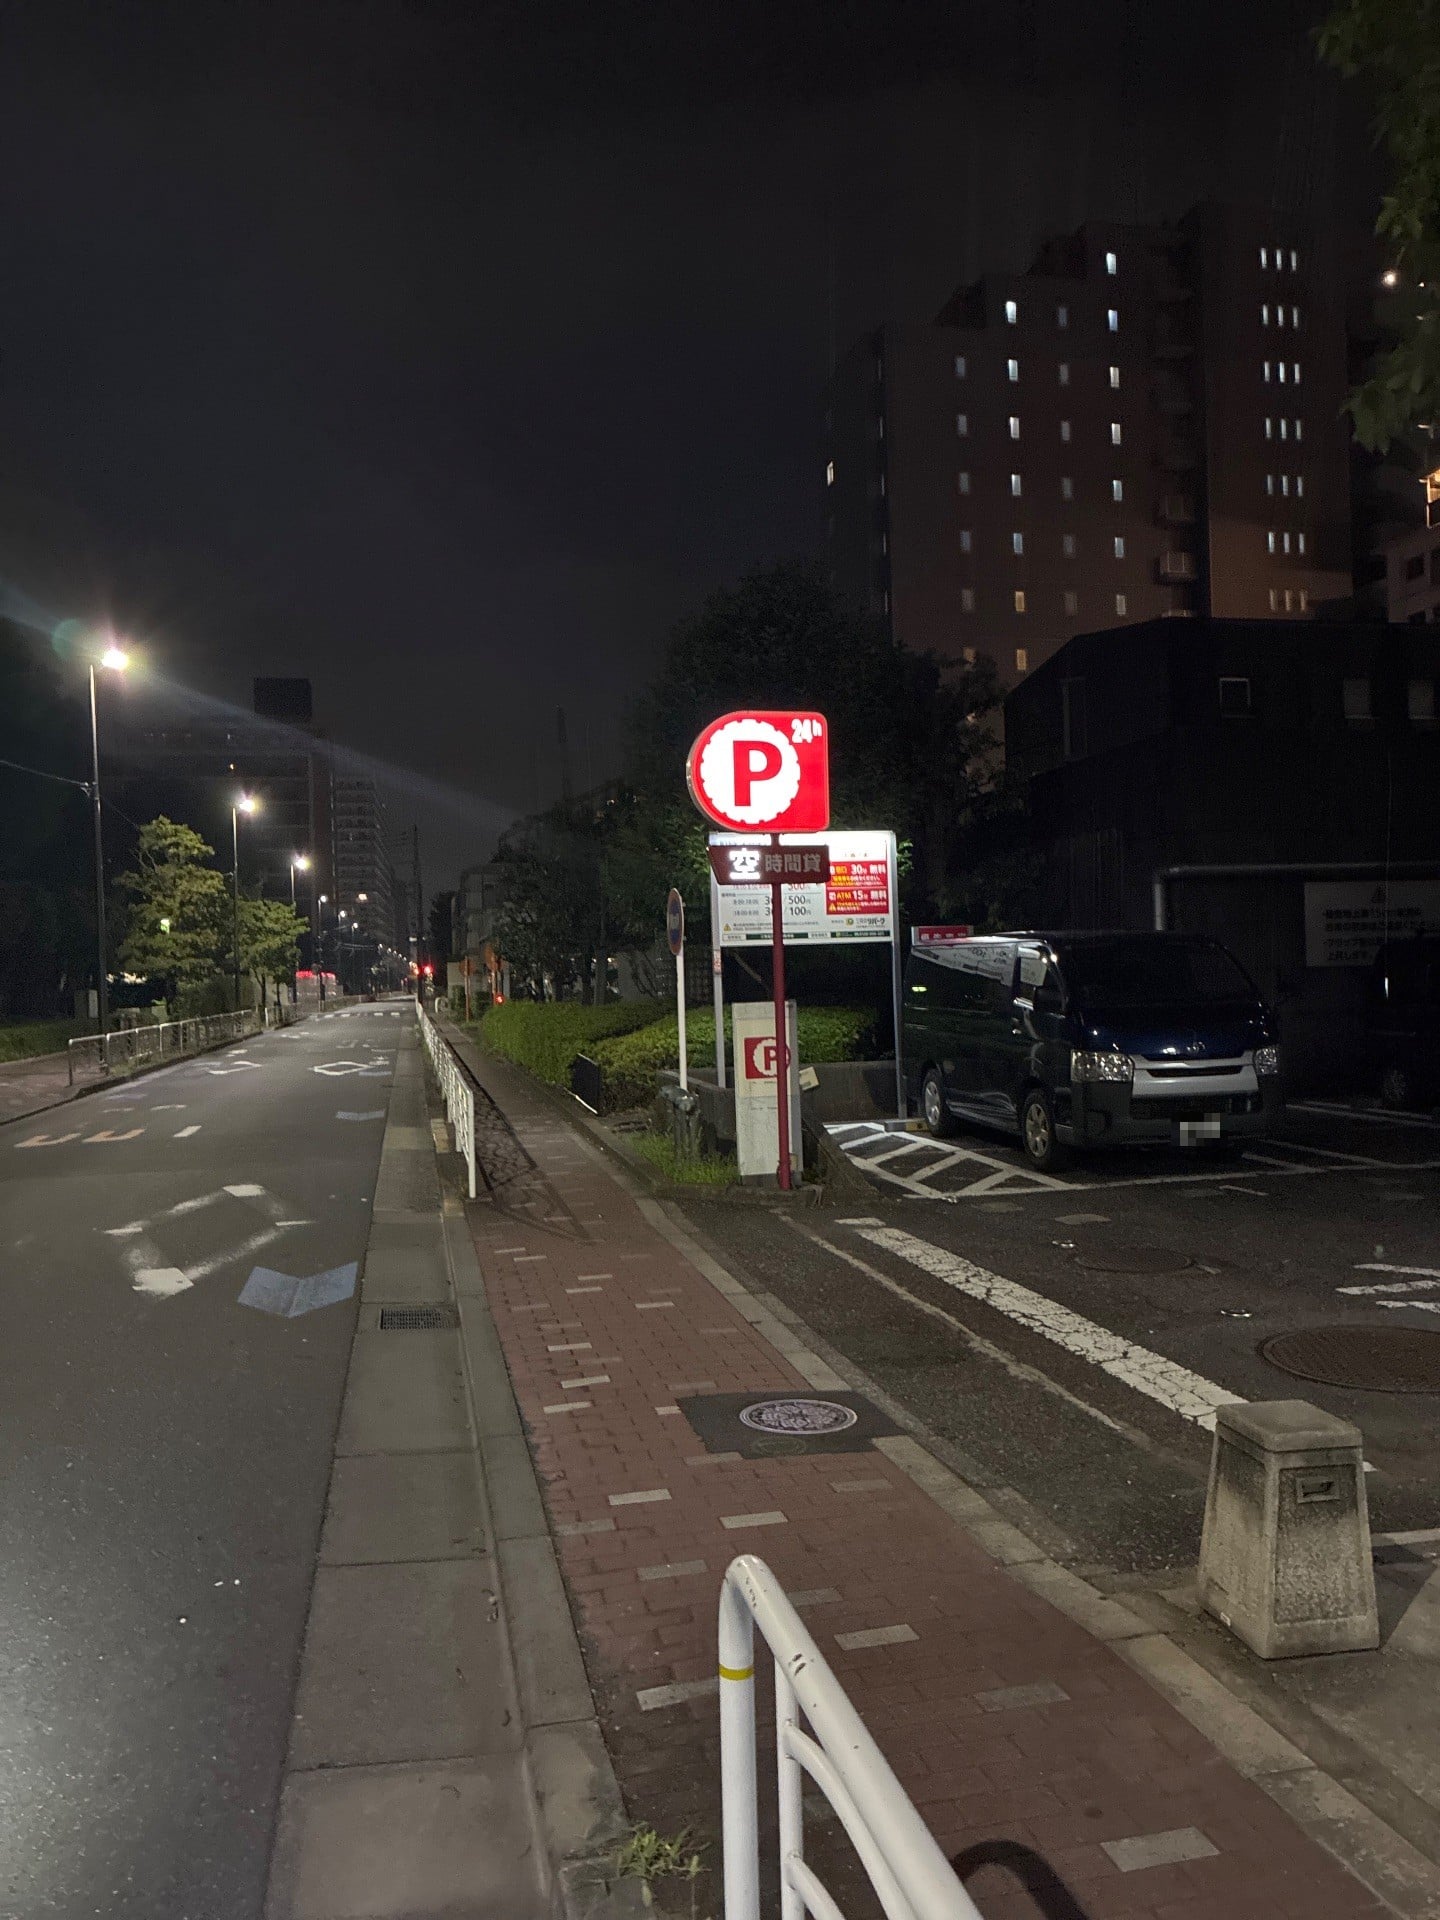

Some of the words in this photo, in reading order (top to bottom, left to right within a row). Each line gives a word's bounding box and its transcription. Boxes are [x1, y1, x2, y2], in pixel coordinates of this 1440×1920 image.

[732, 740, 783, 806] P
[729, 847, 761, 880] 空
[764, 854, 821, 872] 時間貸
[837, 891, 851, 899] ATM
[763, 1045, 778, 1071] P
